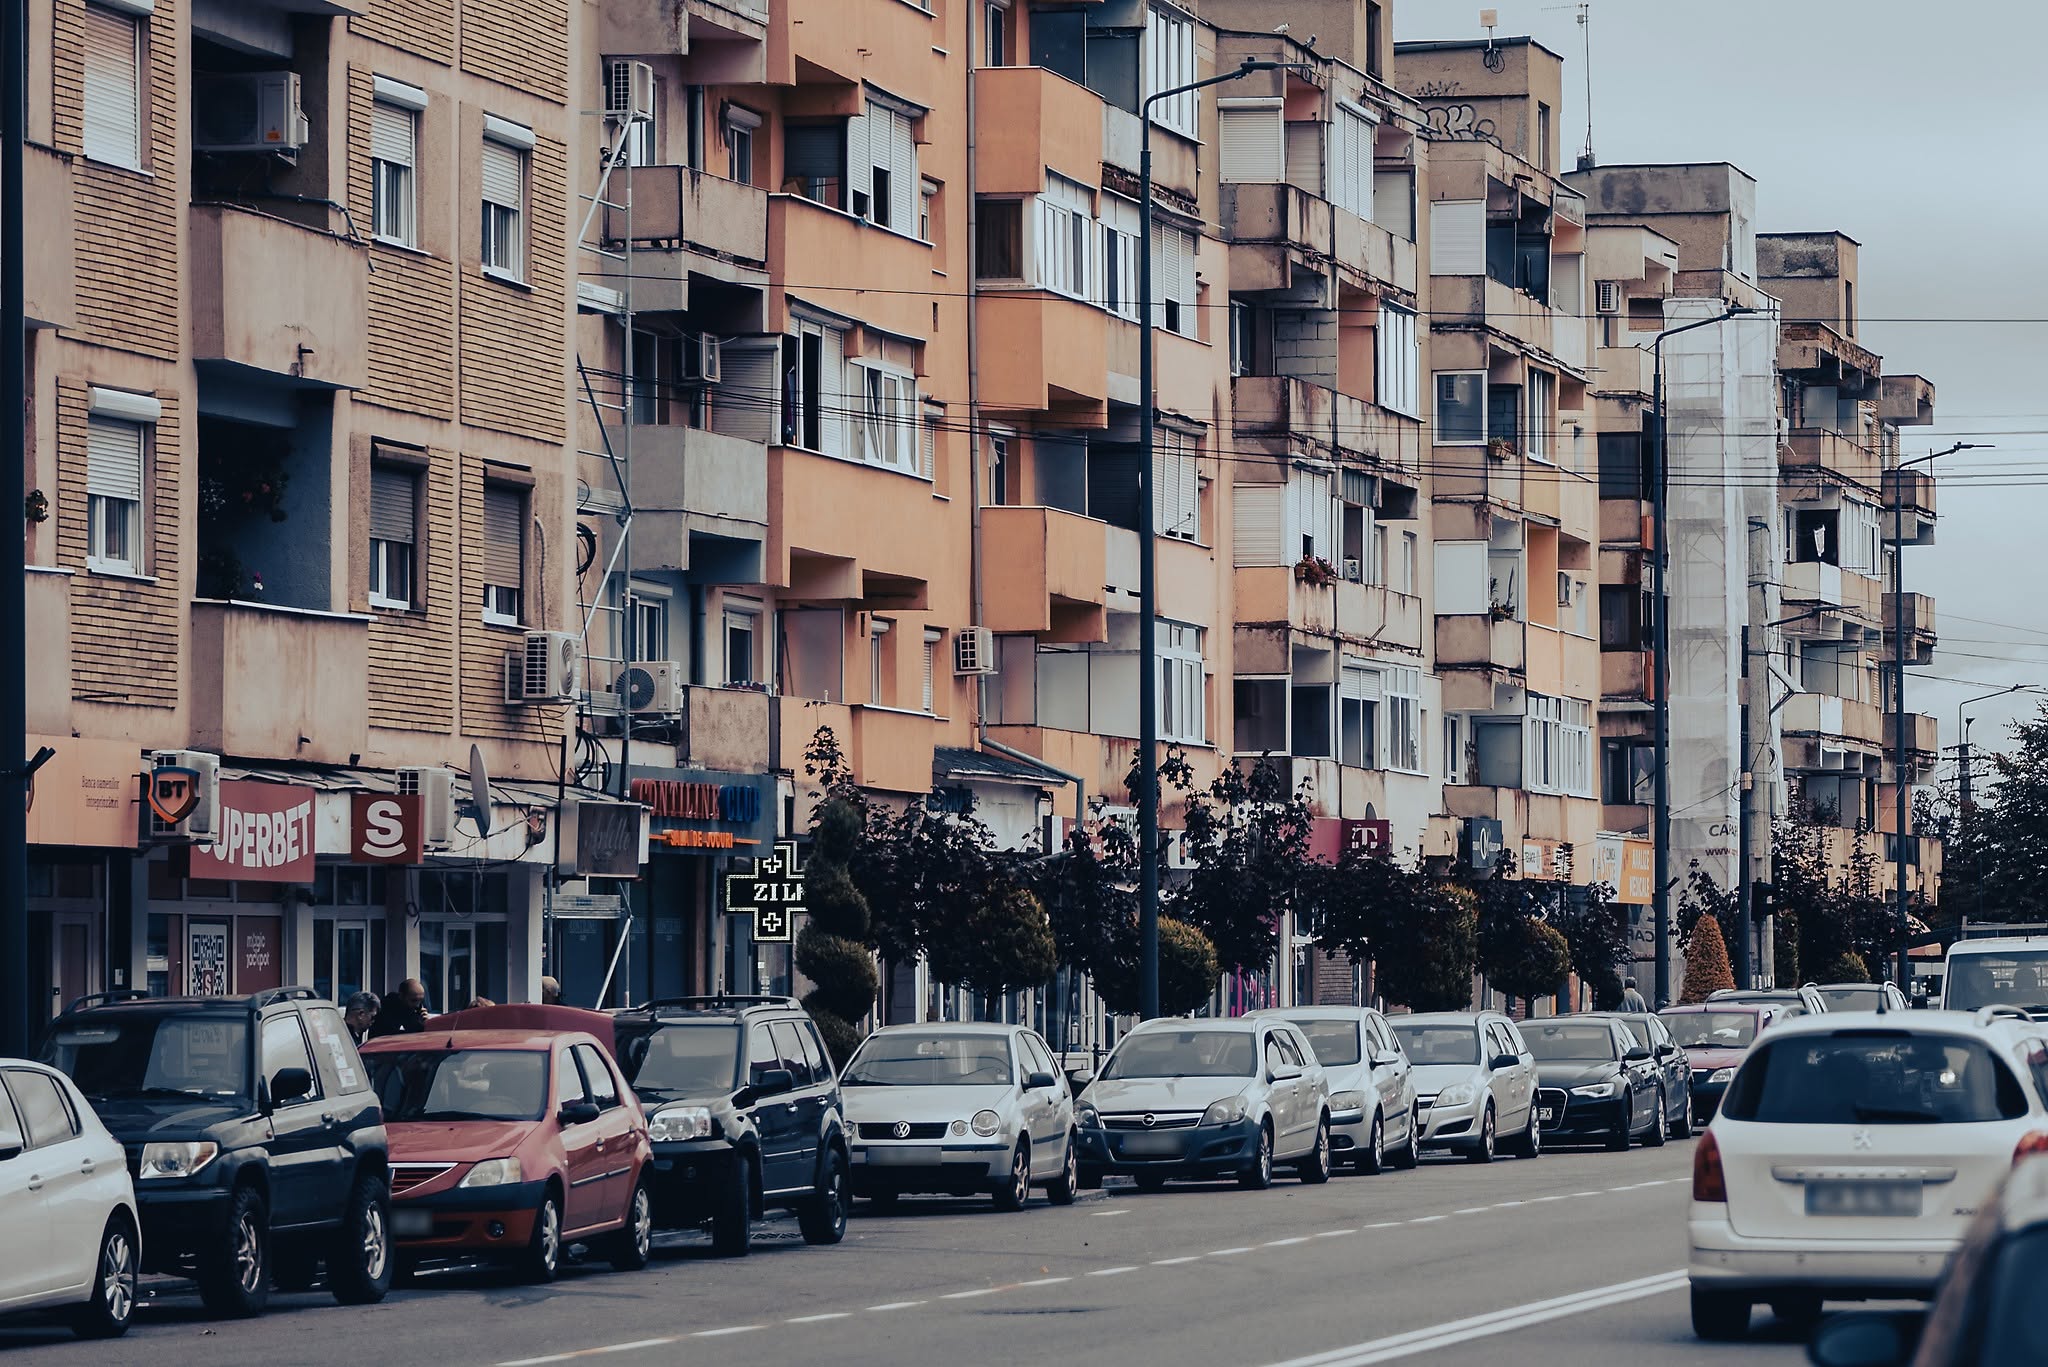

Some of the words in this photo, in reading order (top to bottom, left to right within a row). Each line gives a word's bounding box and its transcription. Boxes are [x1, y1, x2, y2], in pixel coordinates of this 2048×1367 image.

[158, 780, 187, 799] BT
[199, 800, 311, 868] UPERBET
[366, 800, 403, 845] S
